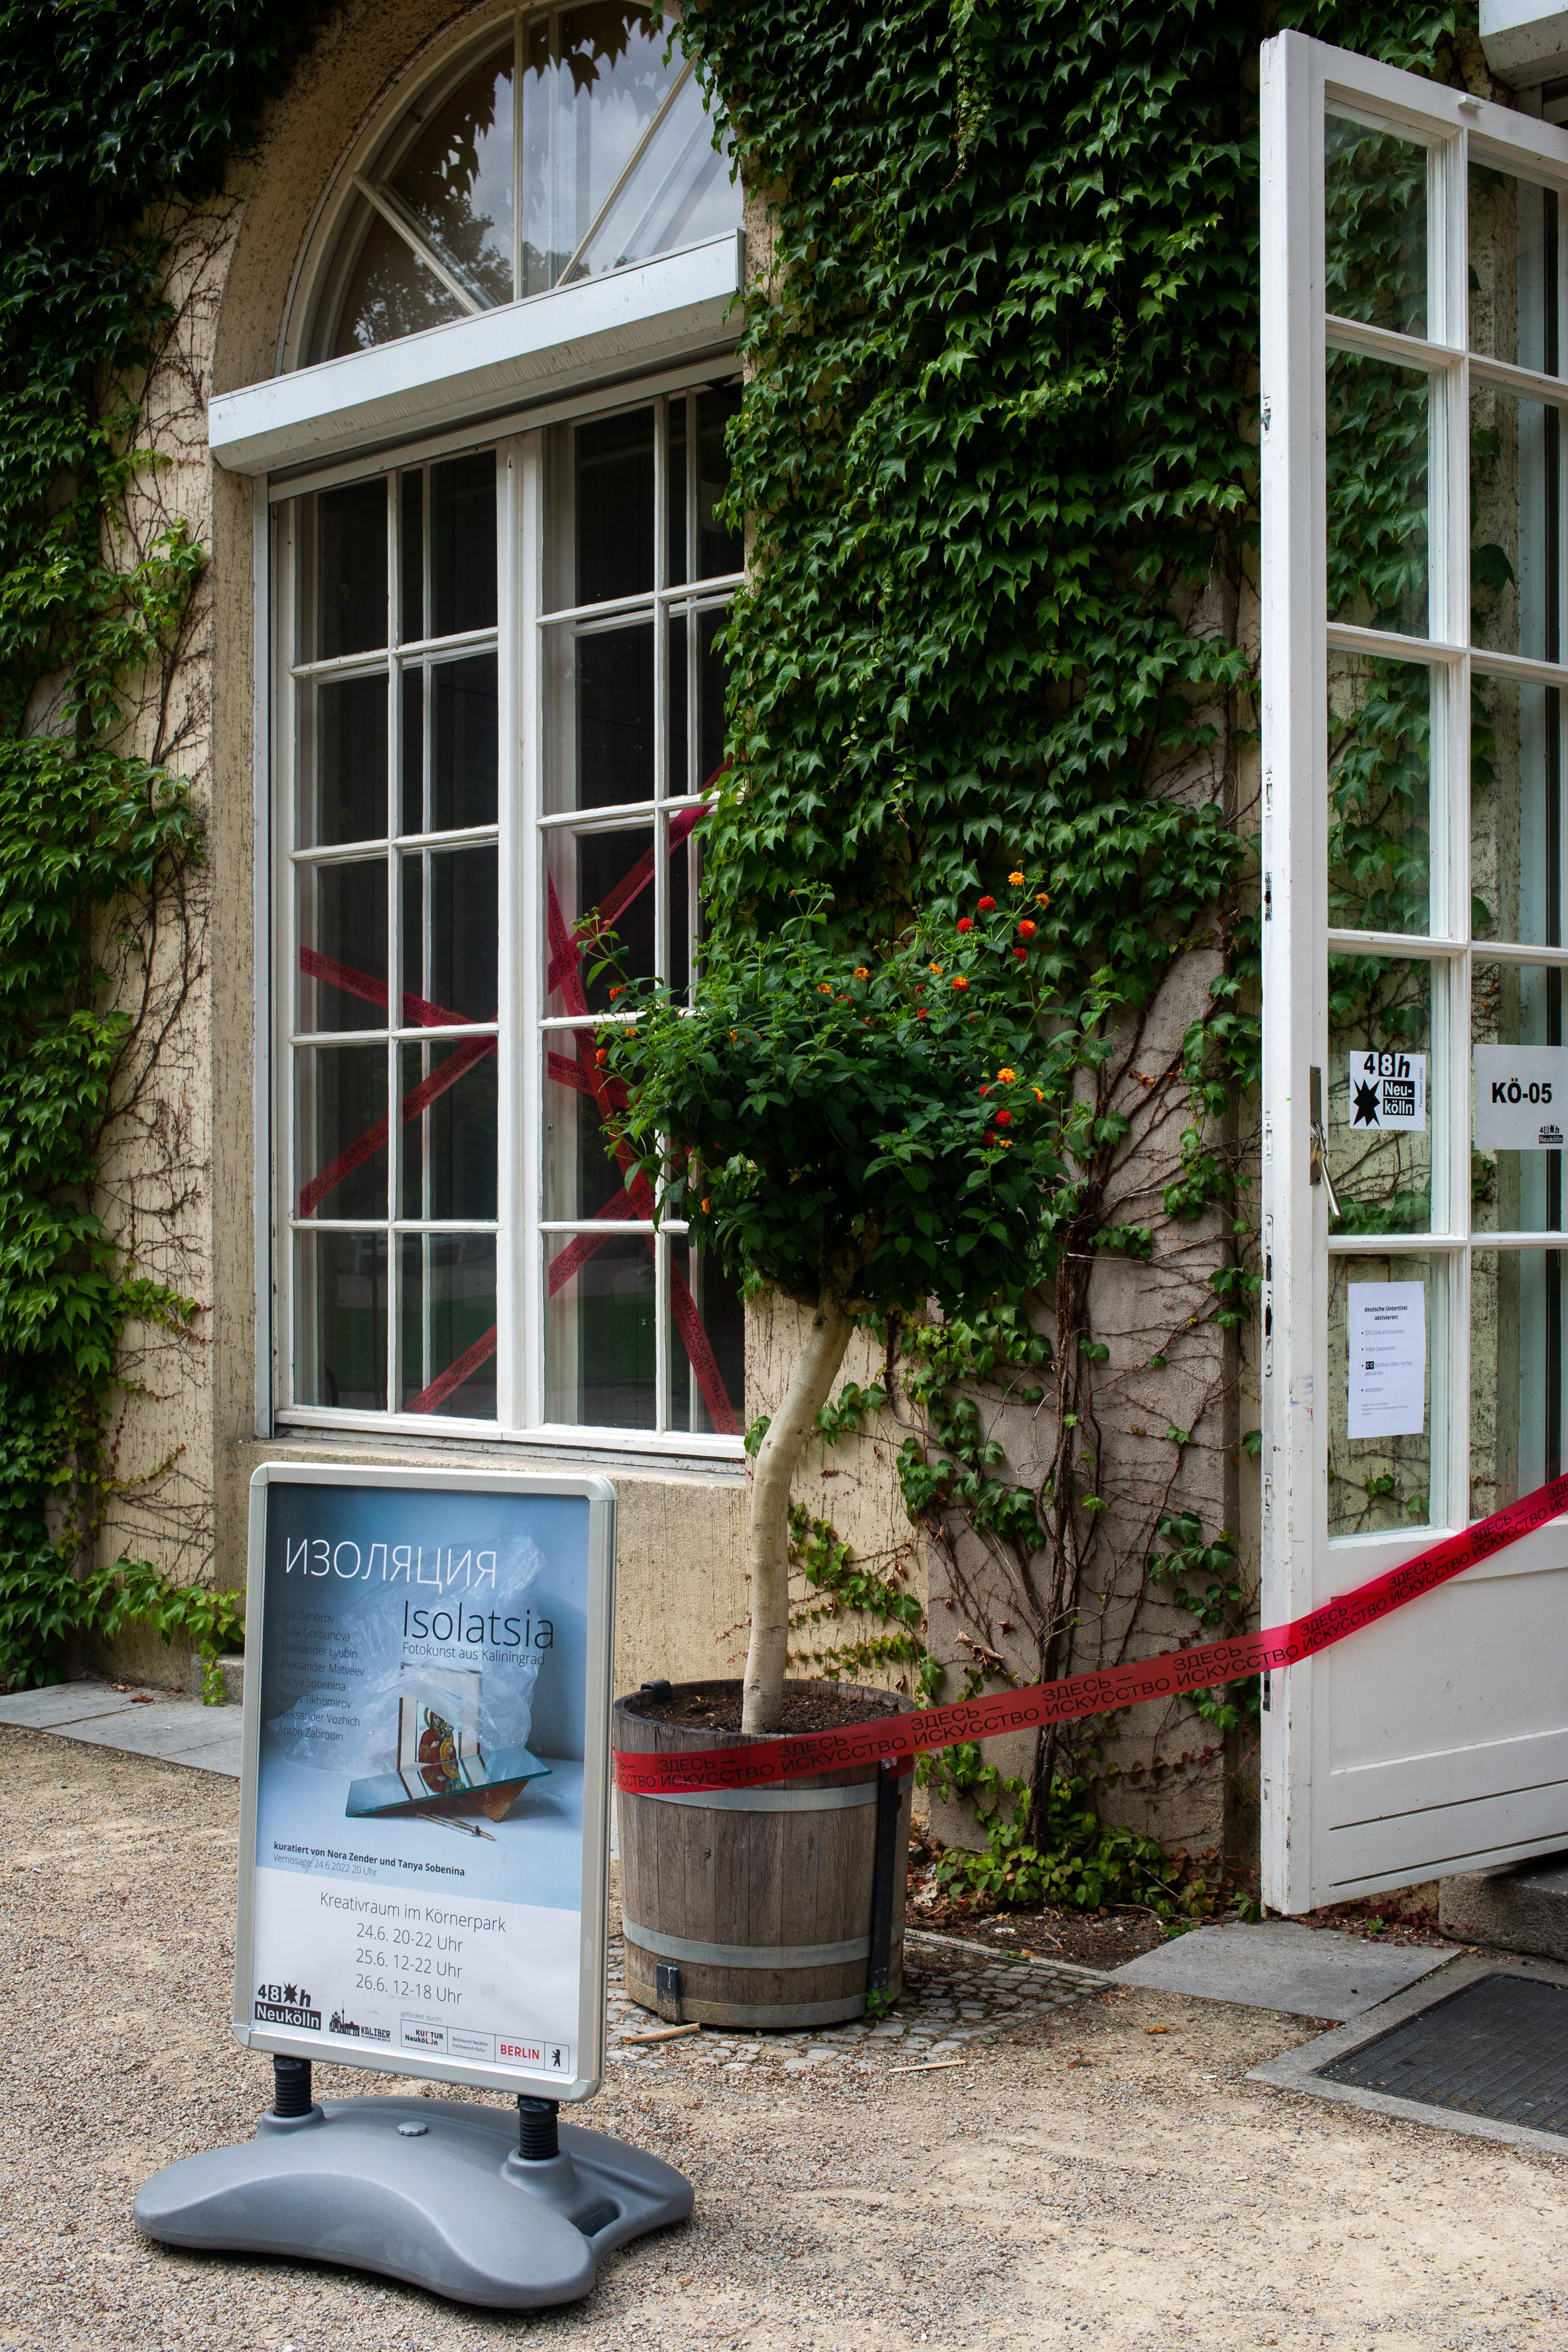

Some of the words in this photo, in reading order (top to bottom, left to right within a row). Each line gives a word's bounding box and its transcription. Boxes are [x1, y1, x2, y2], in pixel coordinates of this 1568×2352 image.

[1364, 1053, 1411, 1078] 48h
[1384, 1081, 1413, 1097] Neu-
[1491, 1077, 1553, 1104] KÖ-05
[1384, 1099, 1413, 1115] kölln
[1539, 1125, 1560, 1135] 48h
[285, 1537, 497, 1594] ИЗОЛЯЦИЯ
[303, 1628, 351, 1642] Gorbunova
[404, 1600, 554, 1650] Isolatsia
[281, 1642, 327, 1656] Aleksander
[329, 1647, 357, 1660] Lyubin
[659, 1758, 716, 1774] ЗДЕСЬ
[778, 1735, 847, 1758] ЗДЕСЬ
[911, 1707, 979, 1731] ЗДЕСЬ
[1043, 1678, 1111, 1701] ЗДЕСЬ
[1174, 1646, 1241, 1671] ЗДЕСЬ
[1300, 1605, 1348, 1636] ЗДЕСЬ
[1387, 1558, 1433, 1591] ЗДЕСЬ
[1470, 1514, 1512, 1545] ЗДЕСЬ
[661, 1764, 774, 1787] ИСКУССТВО
[781, 1737, 907, 1773] ИСКУССТВО
[913, 1708, 1039, 1746] ИСКУССТВО
[1046, 1678, 1170, 1717] ИСКУССТВО
[1177, 1644, 1298, 1686] ИСКУССТВО
[1302, 1598, 1387, 1652] ИСКУССТВО
[1390, 1551, 1470, 1605] ИСКУССТВО
[1472, 1508, 1547, 1558] ИСКУССТВО
[403, 1642, 455, 1658] Fotokunst
[459, 1649, 478, 1660] aus
[482, 1649, 545, 1668] Kaliningrad
[280, 1659, 327, 1672] Aleksander
[329, 1664, 364, 1676] Matveev
[279, 1675, 304, 1689] Tanya
[306, 1678, 346, 1691] Sobenina
[305, 1694, 352, 1709] Tikhomirov
[327, 1713, 360, 1727] Vozhich
[278, 1725, 303, 1737] Anton
[305, 1727, 343, 1741] Zabrodin
[274, 1841, 309, 1854] kuratiert
[311, 1847, 325, 1857] von
[327, 1849, 347, 1859] Nora
[349, 1853, 378, 1864] Zender
[380, 1858, 396, 1867] und
[398, 1859, 423, 1872] Tanya
[425, 1863, 465, 1876] Sobenina
[314, 1859, 350, 1873] 24.6.2022
[352, 1865, 362, 1875] 20
[363, 1866, 377, 1877] Uhr
[320, 1891, 400, 1917] Kreativraum
[404, 1904, 420, 1921] im
[426, 1907, 506, 1932] Körnerpark
[356, 1922, 388, 1942] 24.6.
[393, 1928, 432, 1948] 20-22
[437, 1934, 464, 1952] Uhr
[356, 1948, 388, 1967] 25.6.
[393, 1954, 432, 1974] 12-22
[437, 1960, 463, 1978] Uhr
[356, 1974, 388, 1992] 26.6.
[393, 1980, 431, 1999] 12-18
[437, 1986, 463, 2004] Uhr
[257, 2005, 319, 2029] Neukölln
[361, 2025, 390, 2039] KALIBER
[501, 2044, 540, 2060] BERLIN
